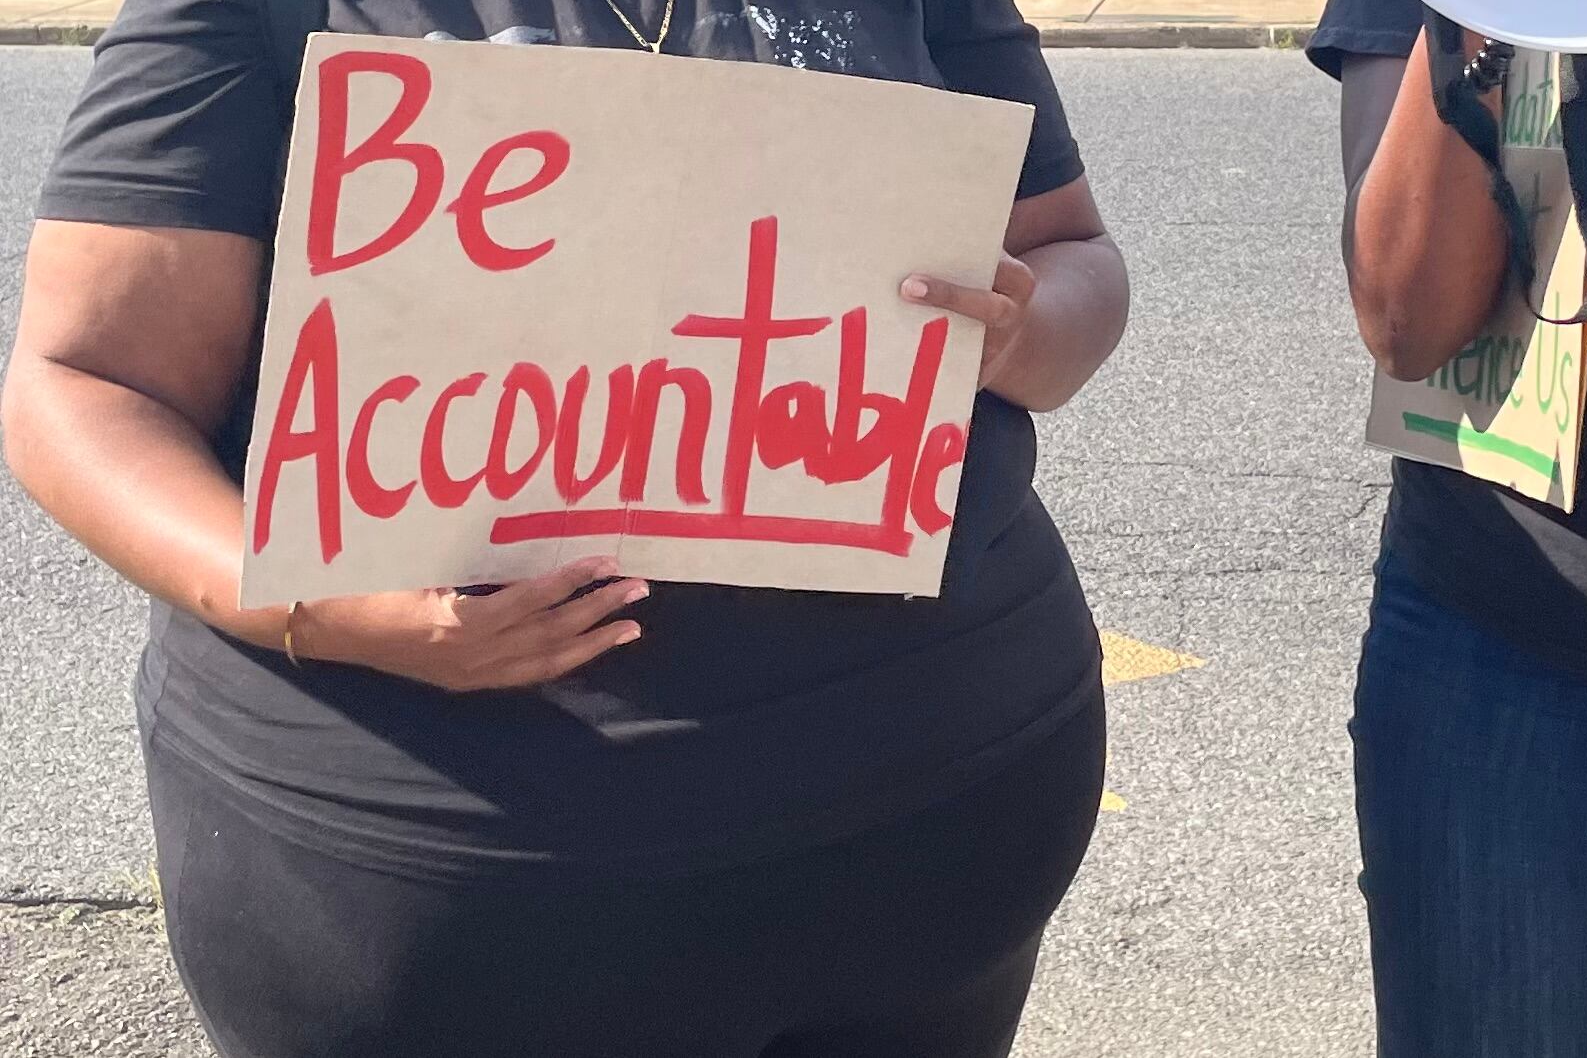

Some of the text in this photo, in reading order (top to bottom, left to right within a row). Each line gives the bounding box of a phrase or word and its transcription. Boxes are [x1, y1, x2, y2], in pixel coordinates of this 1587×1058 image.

[307, 50, 571, 276] Be
[252, 215, 968, 564] Accountable
[1537, 291, 1573, 434] Us
